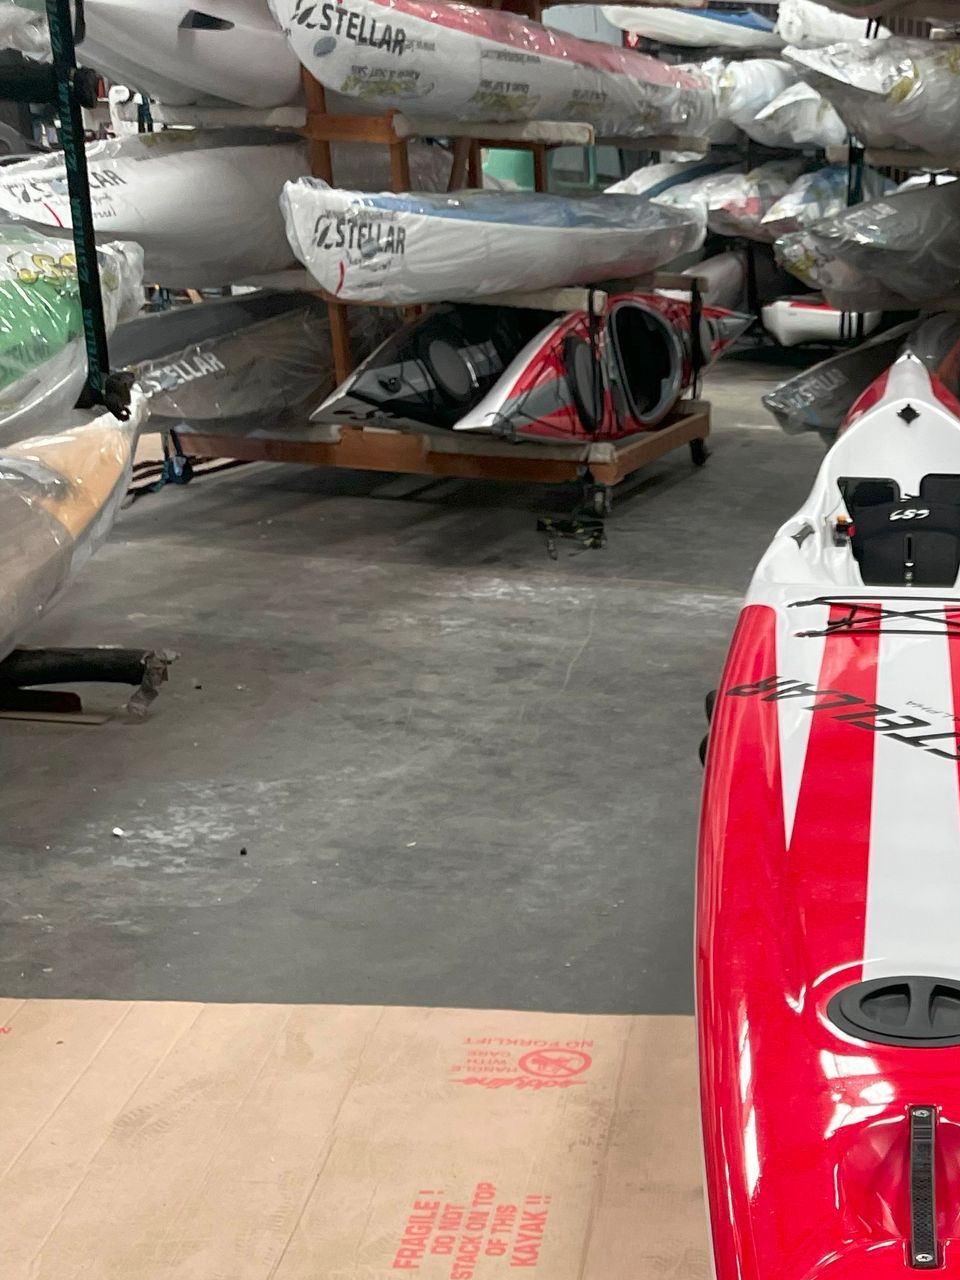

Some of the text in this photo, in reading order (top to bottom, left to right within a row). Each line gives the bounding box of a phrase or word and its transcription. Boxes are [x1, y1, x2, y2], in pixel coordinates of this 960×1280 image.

[320, 3, 406, 56] STELLAR
[335, 217, 406, 254] STELLAR
[392, 1200, 440, 1269] FRAGILE
[430, 1203, 465, 1255] DO NOT
[450, 1182, 496, 1280] STACK ON TOP
[485, 1204, 517, 1256] OF THIS
[510, 1210, 548, 1267] KAYAK
